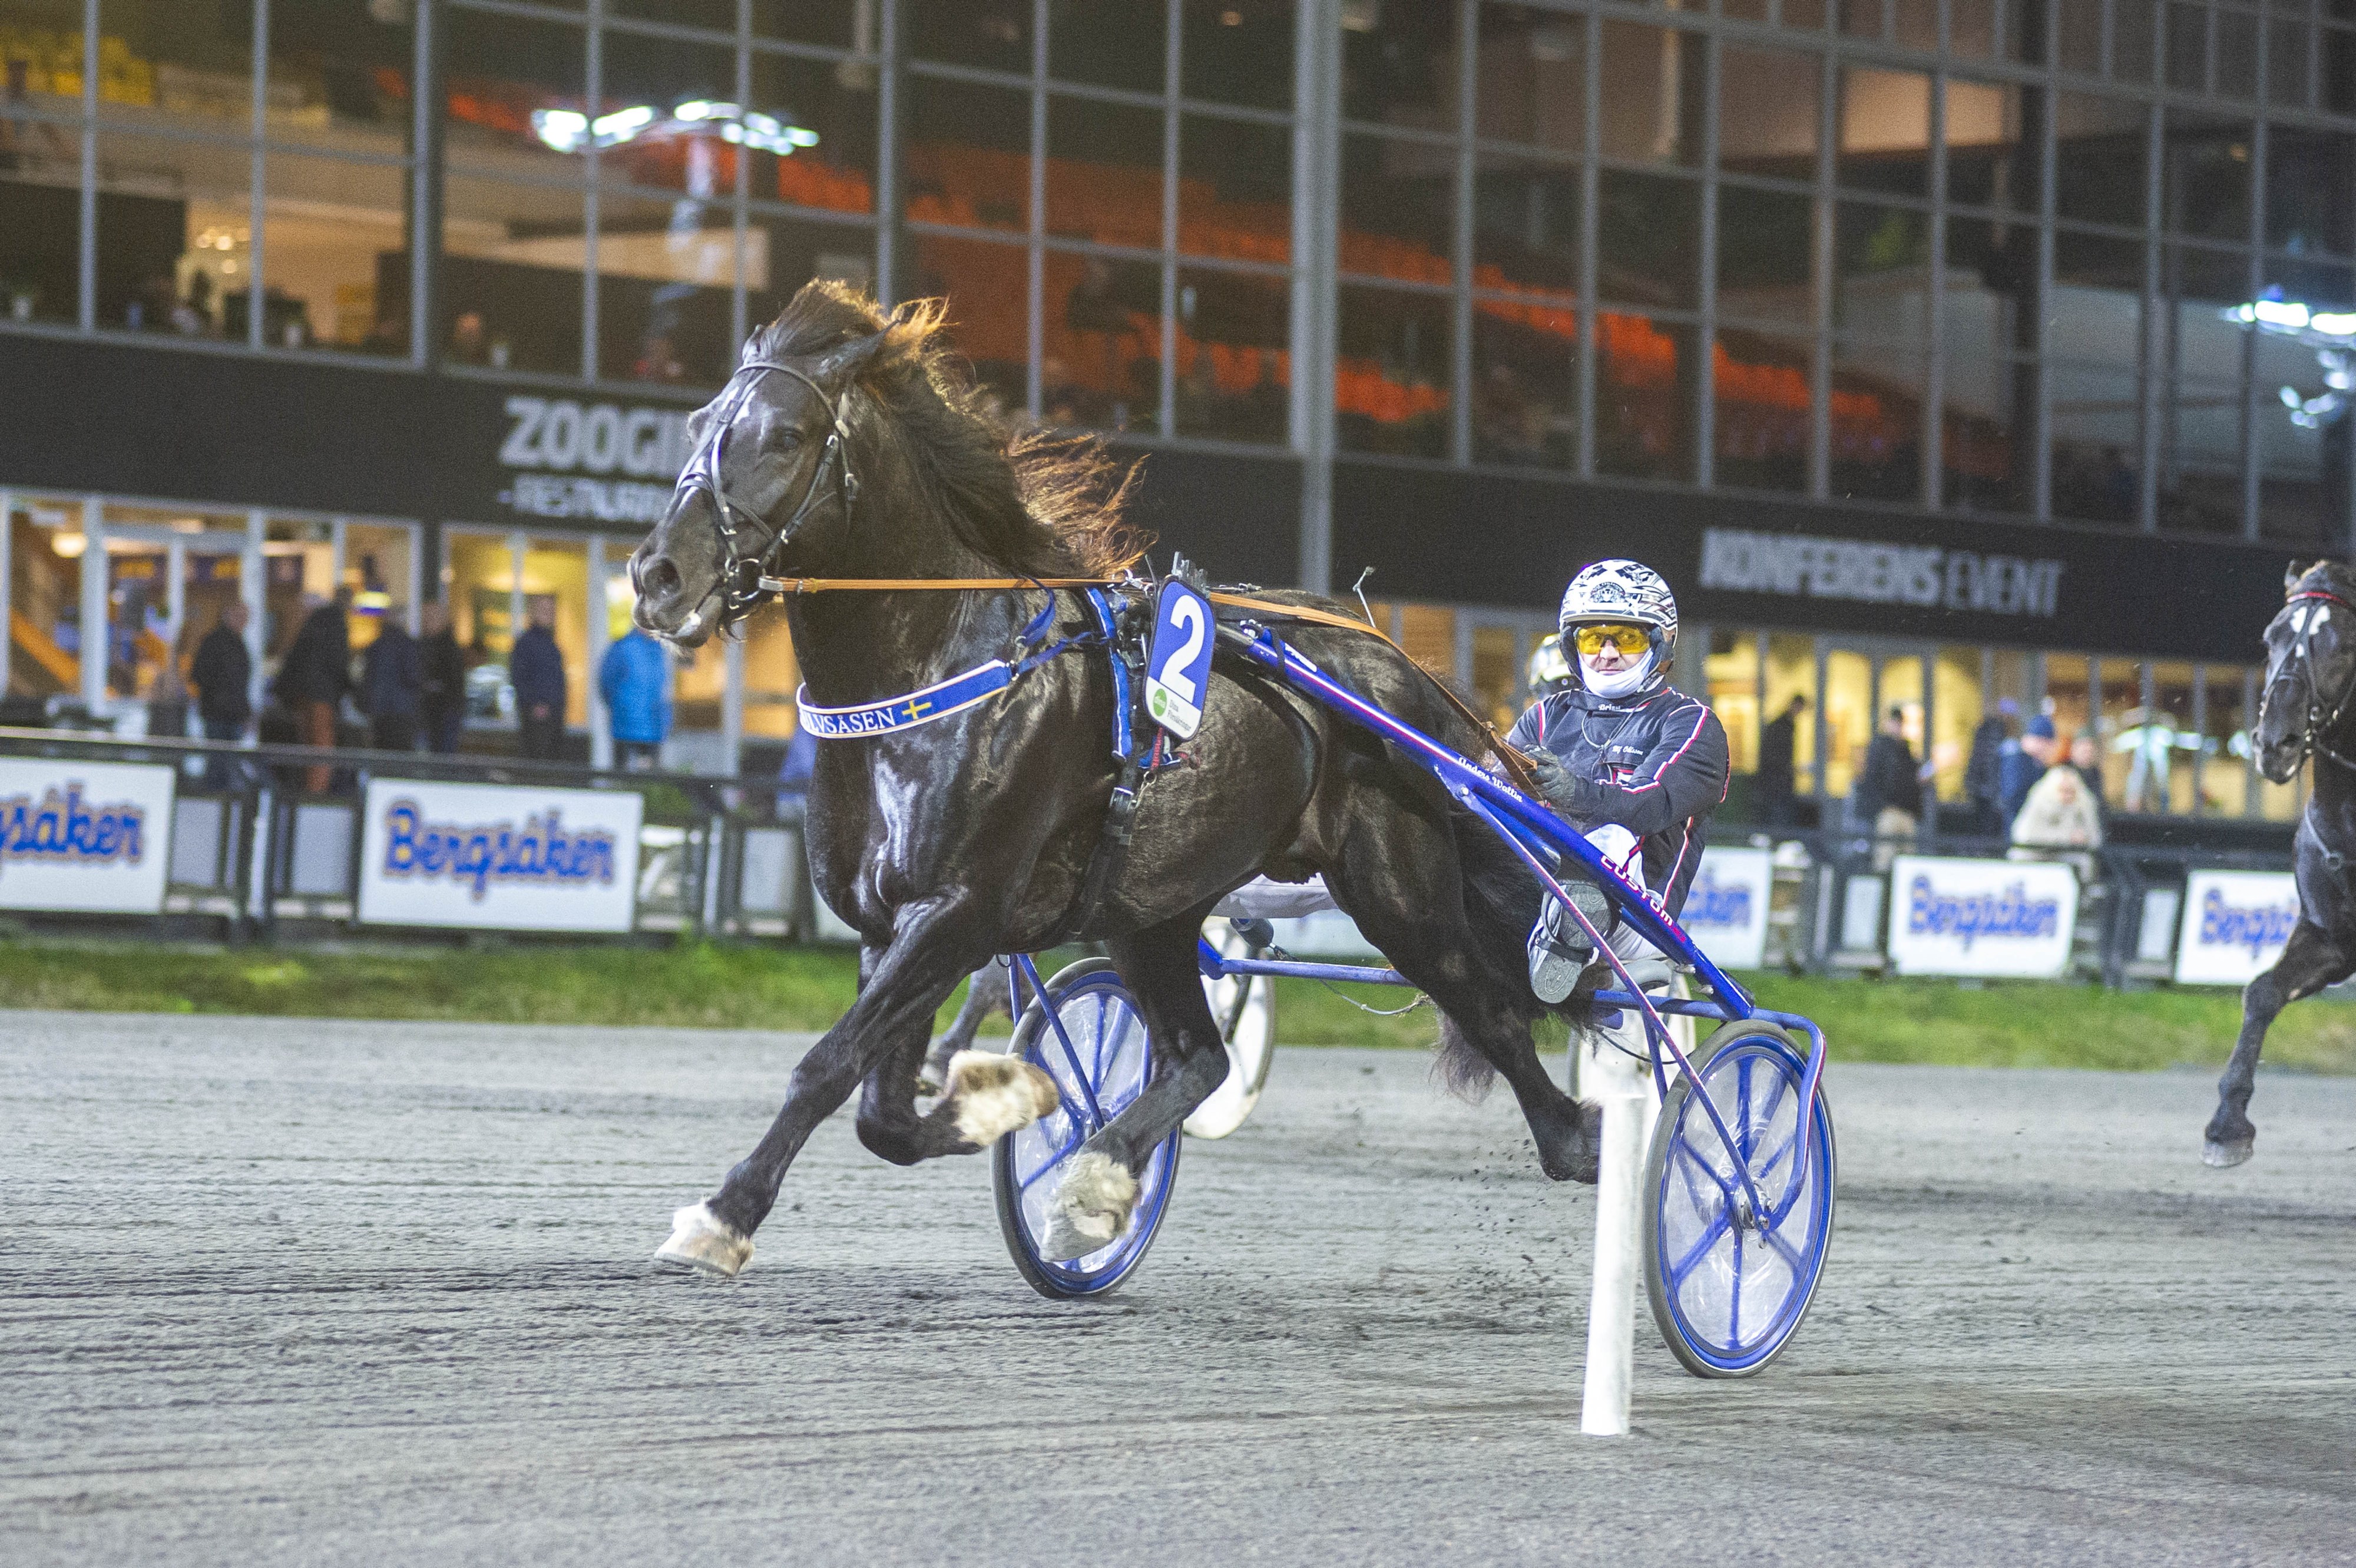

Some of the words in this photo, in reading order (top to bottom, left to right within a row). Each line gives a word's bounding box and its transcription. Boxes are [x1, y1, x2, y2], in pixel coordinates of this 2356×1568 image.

[501, 396, 689, 476] ZOOGI
[1699, 527, 1943, 607] KONFERENS
[1944, 549, 2063, 618] EVENT
[1159, 594, 1205, 703] 2
[1458, 757, 1490, 781] Anders
[1492, 776, 1523, 802] Wallin
[0, 782, 145, 865] såker
[1601, 854, 1673, 927] CUSTOM
